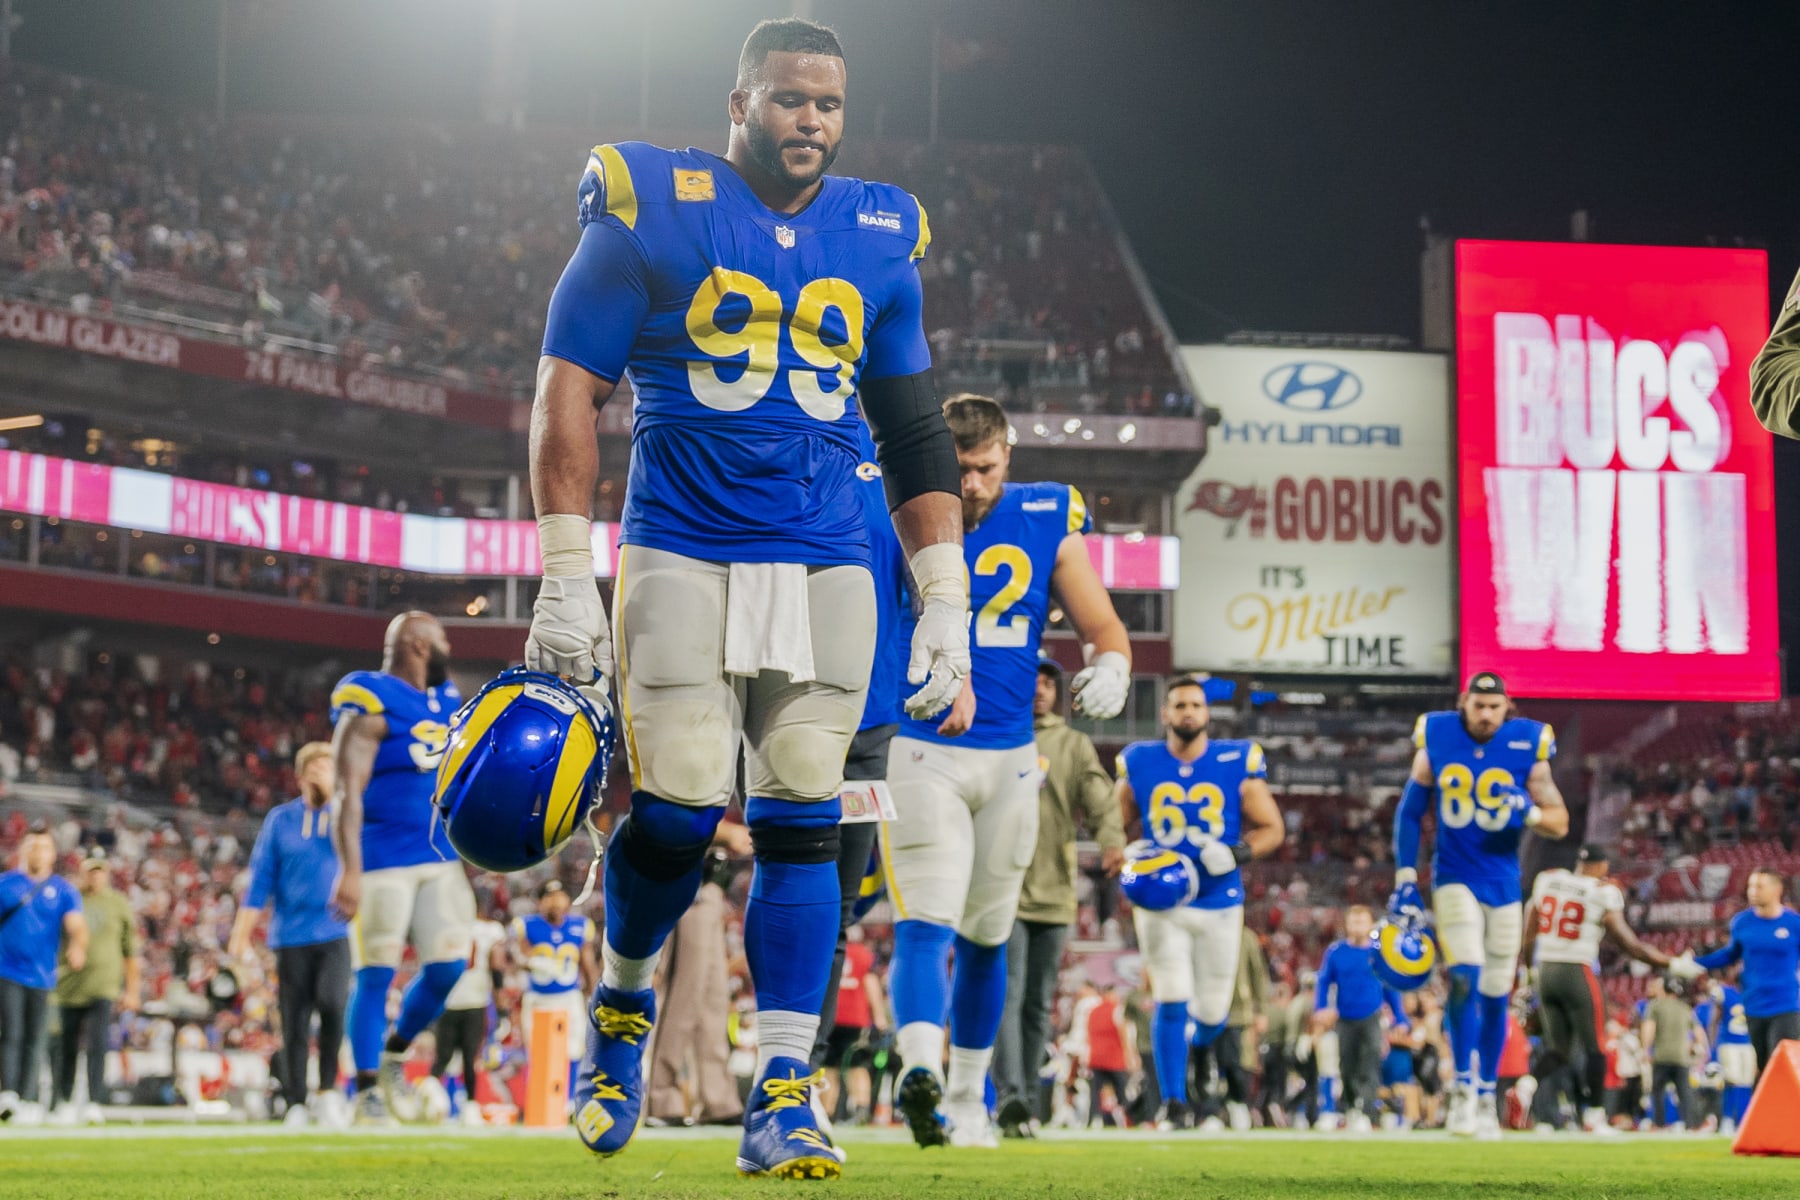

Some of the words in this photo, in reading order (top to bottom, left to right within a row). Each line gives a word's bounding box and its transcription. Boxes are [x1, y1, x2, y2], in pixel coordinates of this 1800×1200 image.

[859, 213, 901, 231] RAMS
[71, 316, 180, 369] GLAZER
[686, 266, 864, 421] 99
[1493, 312, 1733, 473] BUCS
[1222, 421, 1403, 447] HYUNDAI
[1260, 565, 1306, 588] IT'S
[1482, 466, 1750, 655] WIN
[1226, 586, 1408, 665] Miller
[1322, 635, 1405, 668] TIME
[1148, 781, 1226, 849] 63
[1438, 762, 1515, 833] 89
